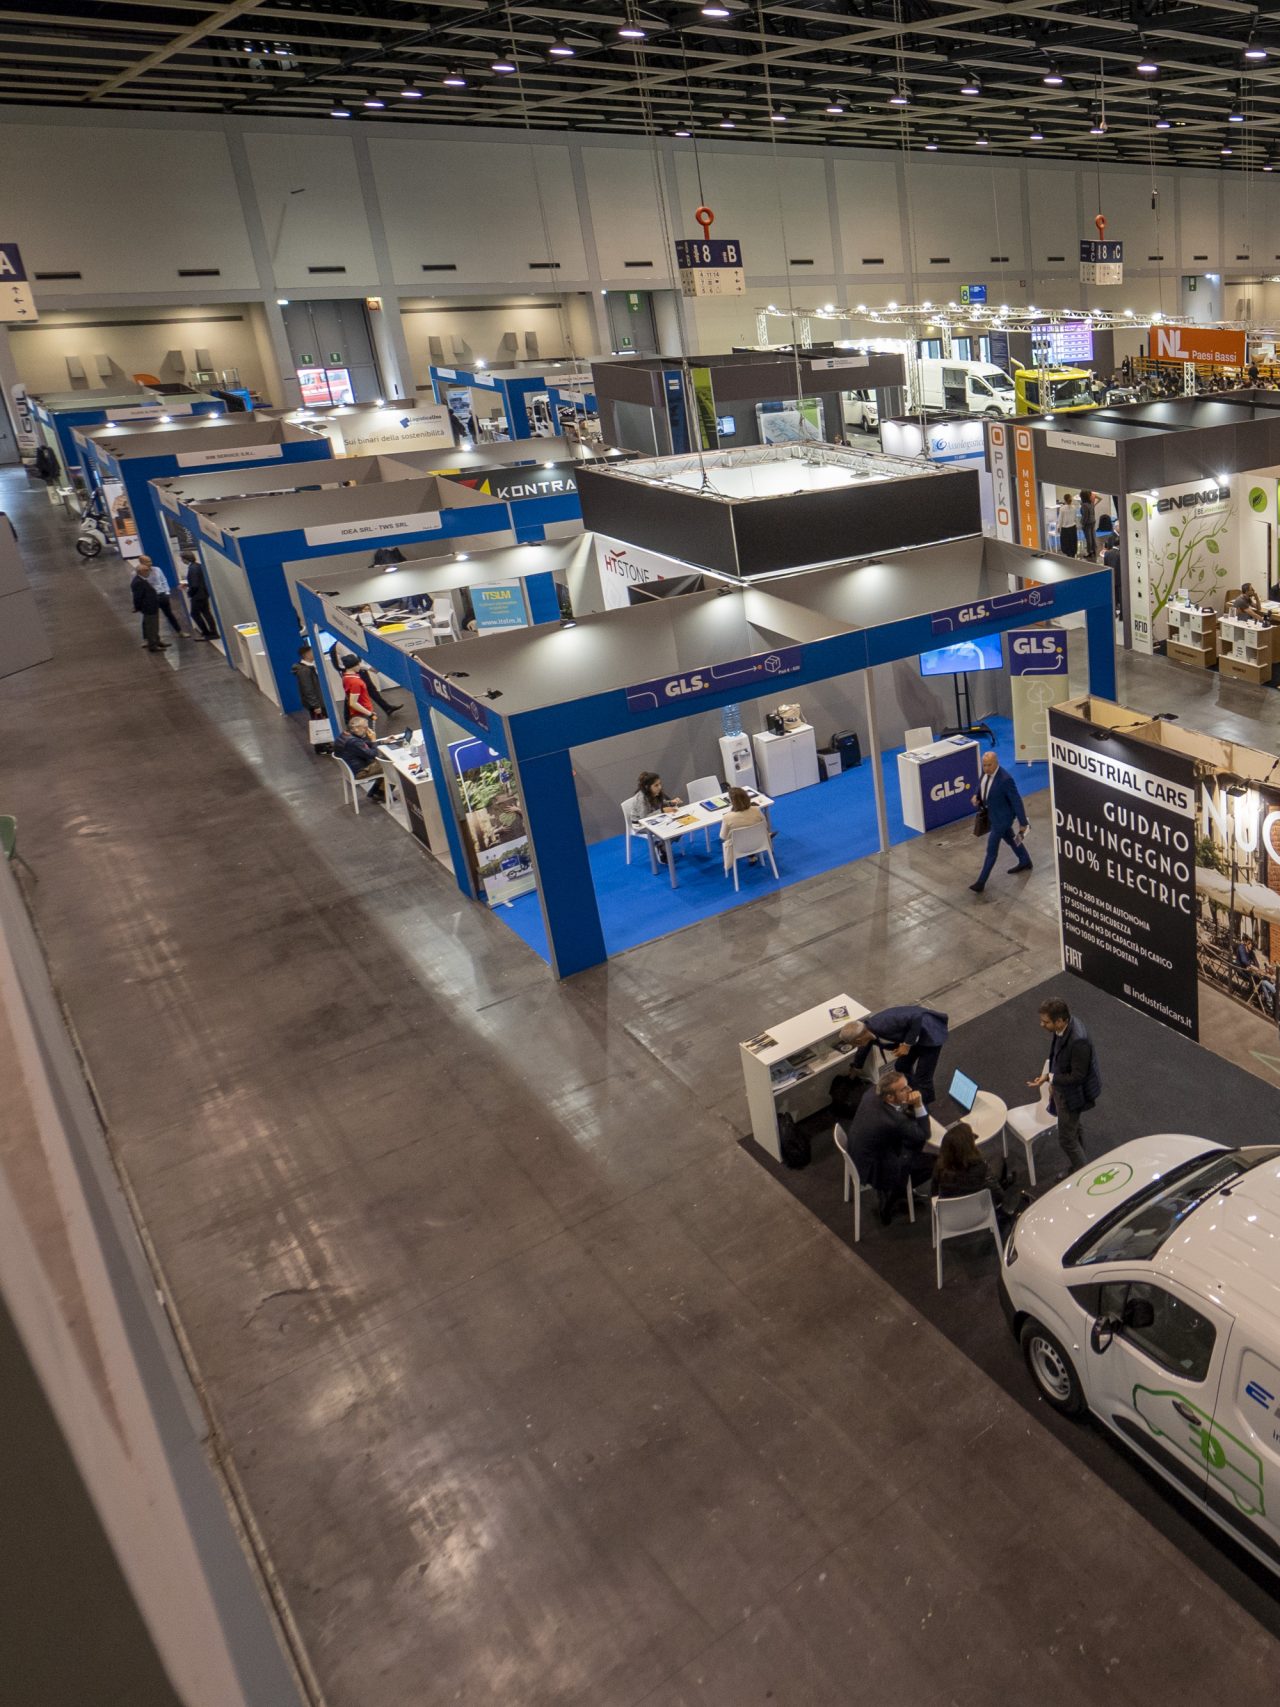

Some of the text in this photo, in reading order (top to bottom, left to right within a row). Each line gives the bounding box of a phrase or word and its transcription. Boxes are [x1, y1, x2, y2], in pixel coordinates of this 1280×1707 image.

[727, 245, 737, 262] B
[1115, 245, 1121, 259] C
[962, 289, 969, 301] 8
[1157, 328, 1237, 363] NL Paesi Bassi
[358, 436, 380, 445] binari
[382, 434, 400, 443] della
[340, 527, 357, 536] IDEA
[359, 526, 373, 534] SRL
[379, 523, 393, 532] TWS
[394, 521, 409, 530] SRL
[1051, 742, 1188, 810] INDUSTRIAL CARS
[1055, 808, 1190, 883] DALL'INGEGNO
[1103, 801, 1189, 852] GUIDATO
[1055, 836, 1191, 914] 100% ELECTRIC
[1063, 881, 1079, 895] FINO
[1083, 891, 1095, 904] 280
[1095, 897, 1105, 908] KM
[1105, 902, 1112, 911] DI
[1112, 906, 1151, 931] AUTONOMIA
[1064, 895, 1132, 935] 17 SISTEMI DI SICUREZZA
[1064, 944, 1083, 971] FIAT
[1065, 909, 1080, 922] FINO
[1080, 917, 1085, 925] A
[1095, 924, 1104, 935] M3
[1104, 929, 1111, 939] DI
[1111, 932, 1140, 953] CAPACITÀ
[1140, 947, 1148, 957] DI
[1147, 951, 1173, 970] CARICO
[1065, 922, 1139, 967] FINO 1000 KG DI PORTATA
[1132, 986, 1192, 1028] industrialcars.it
[1245, 1380, 1275, 1410] E
